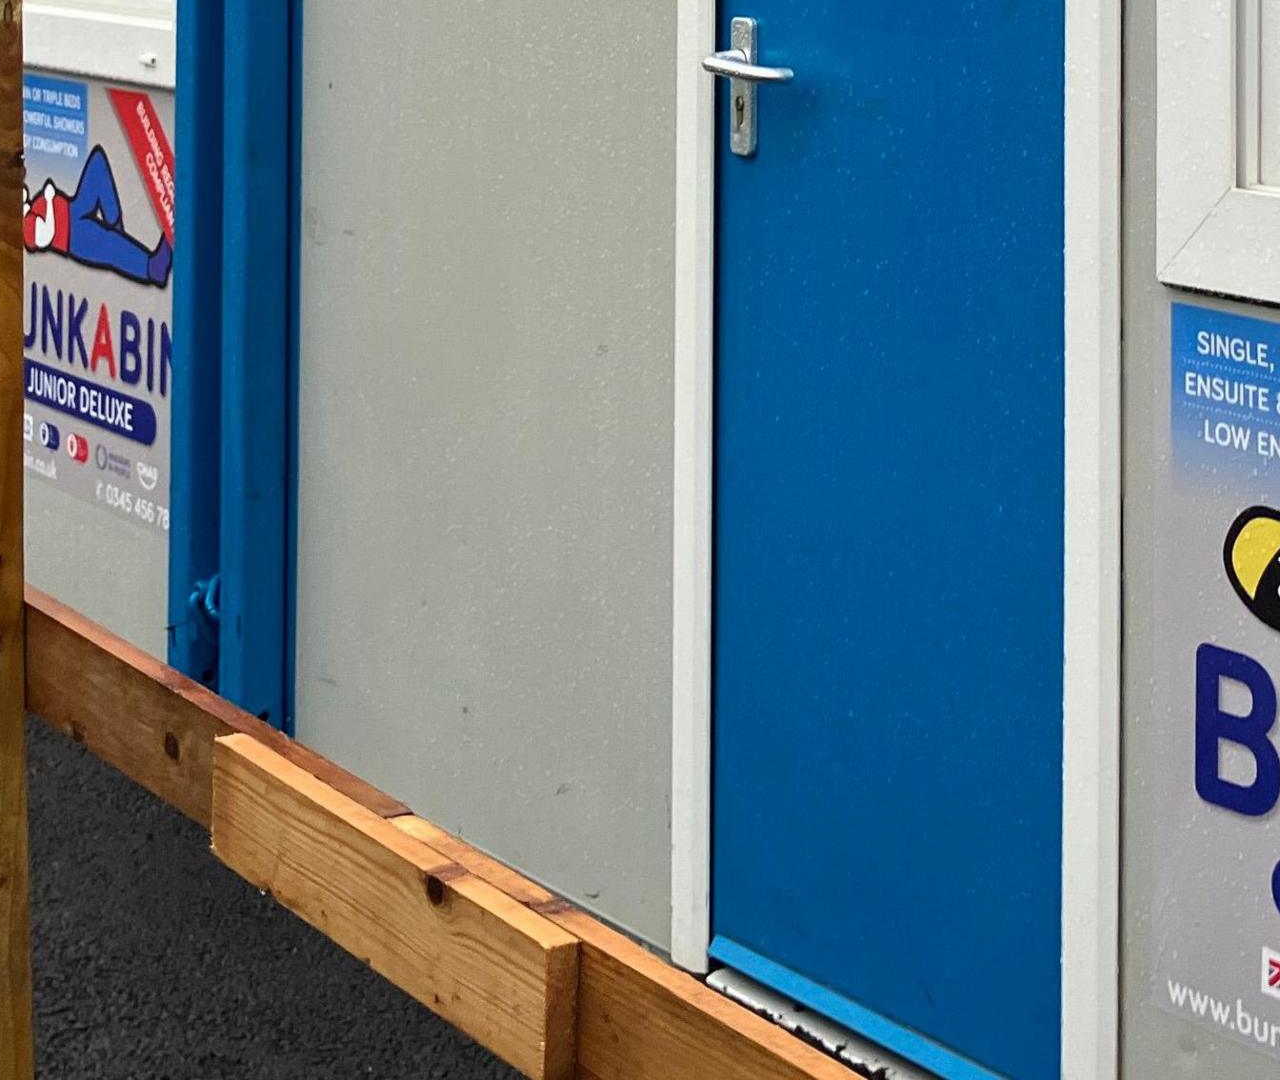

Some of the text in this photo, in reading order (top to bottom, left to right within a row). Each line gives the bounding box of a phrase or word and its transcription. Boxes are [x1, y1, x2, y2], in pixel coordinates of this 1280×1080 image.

[1197, 331, 1275, 373] SINGLE,
[28, 367, 76, 409] JUNIOR
[80, 386, 134, 432] DELUXE
[1185, 373, 1268, 411] ENSUITE
[1204, 419, 1250, 451] LOW
